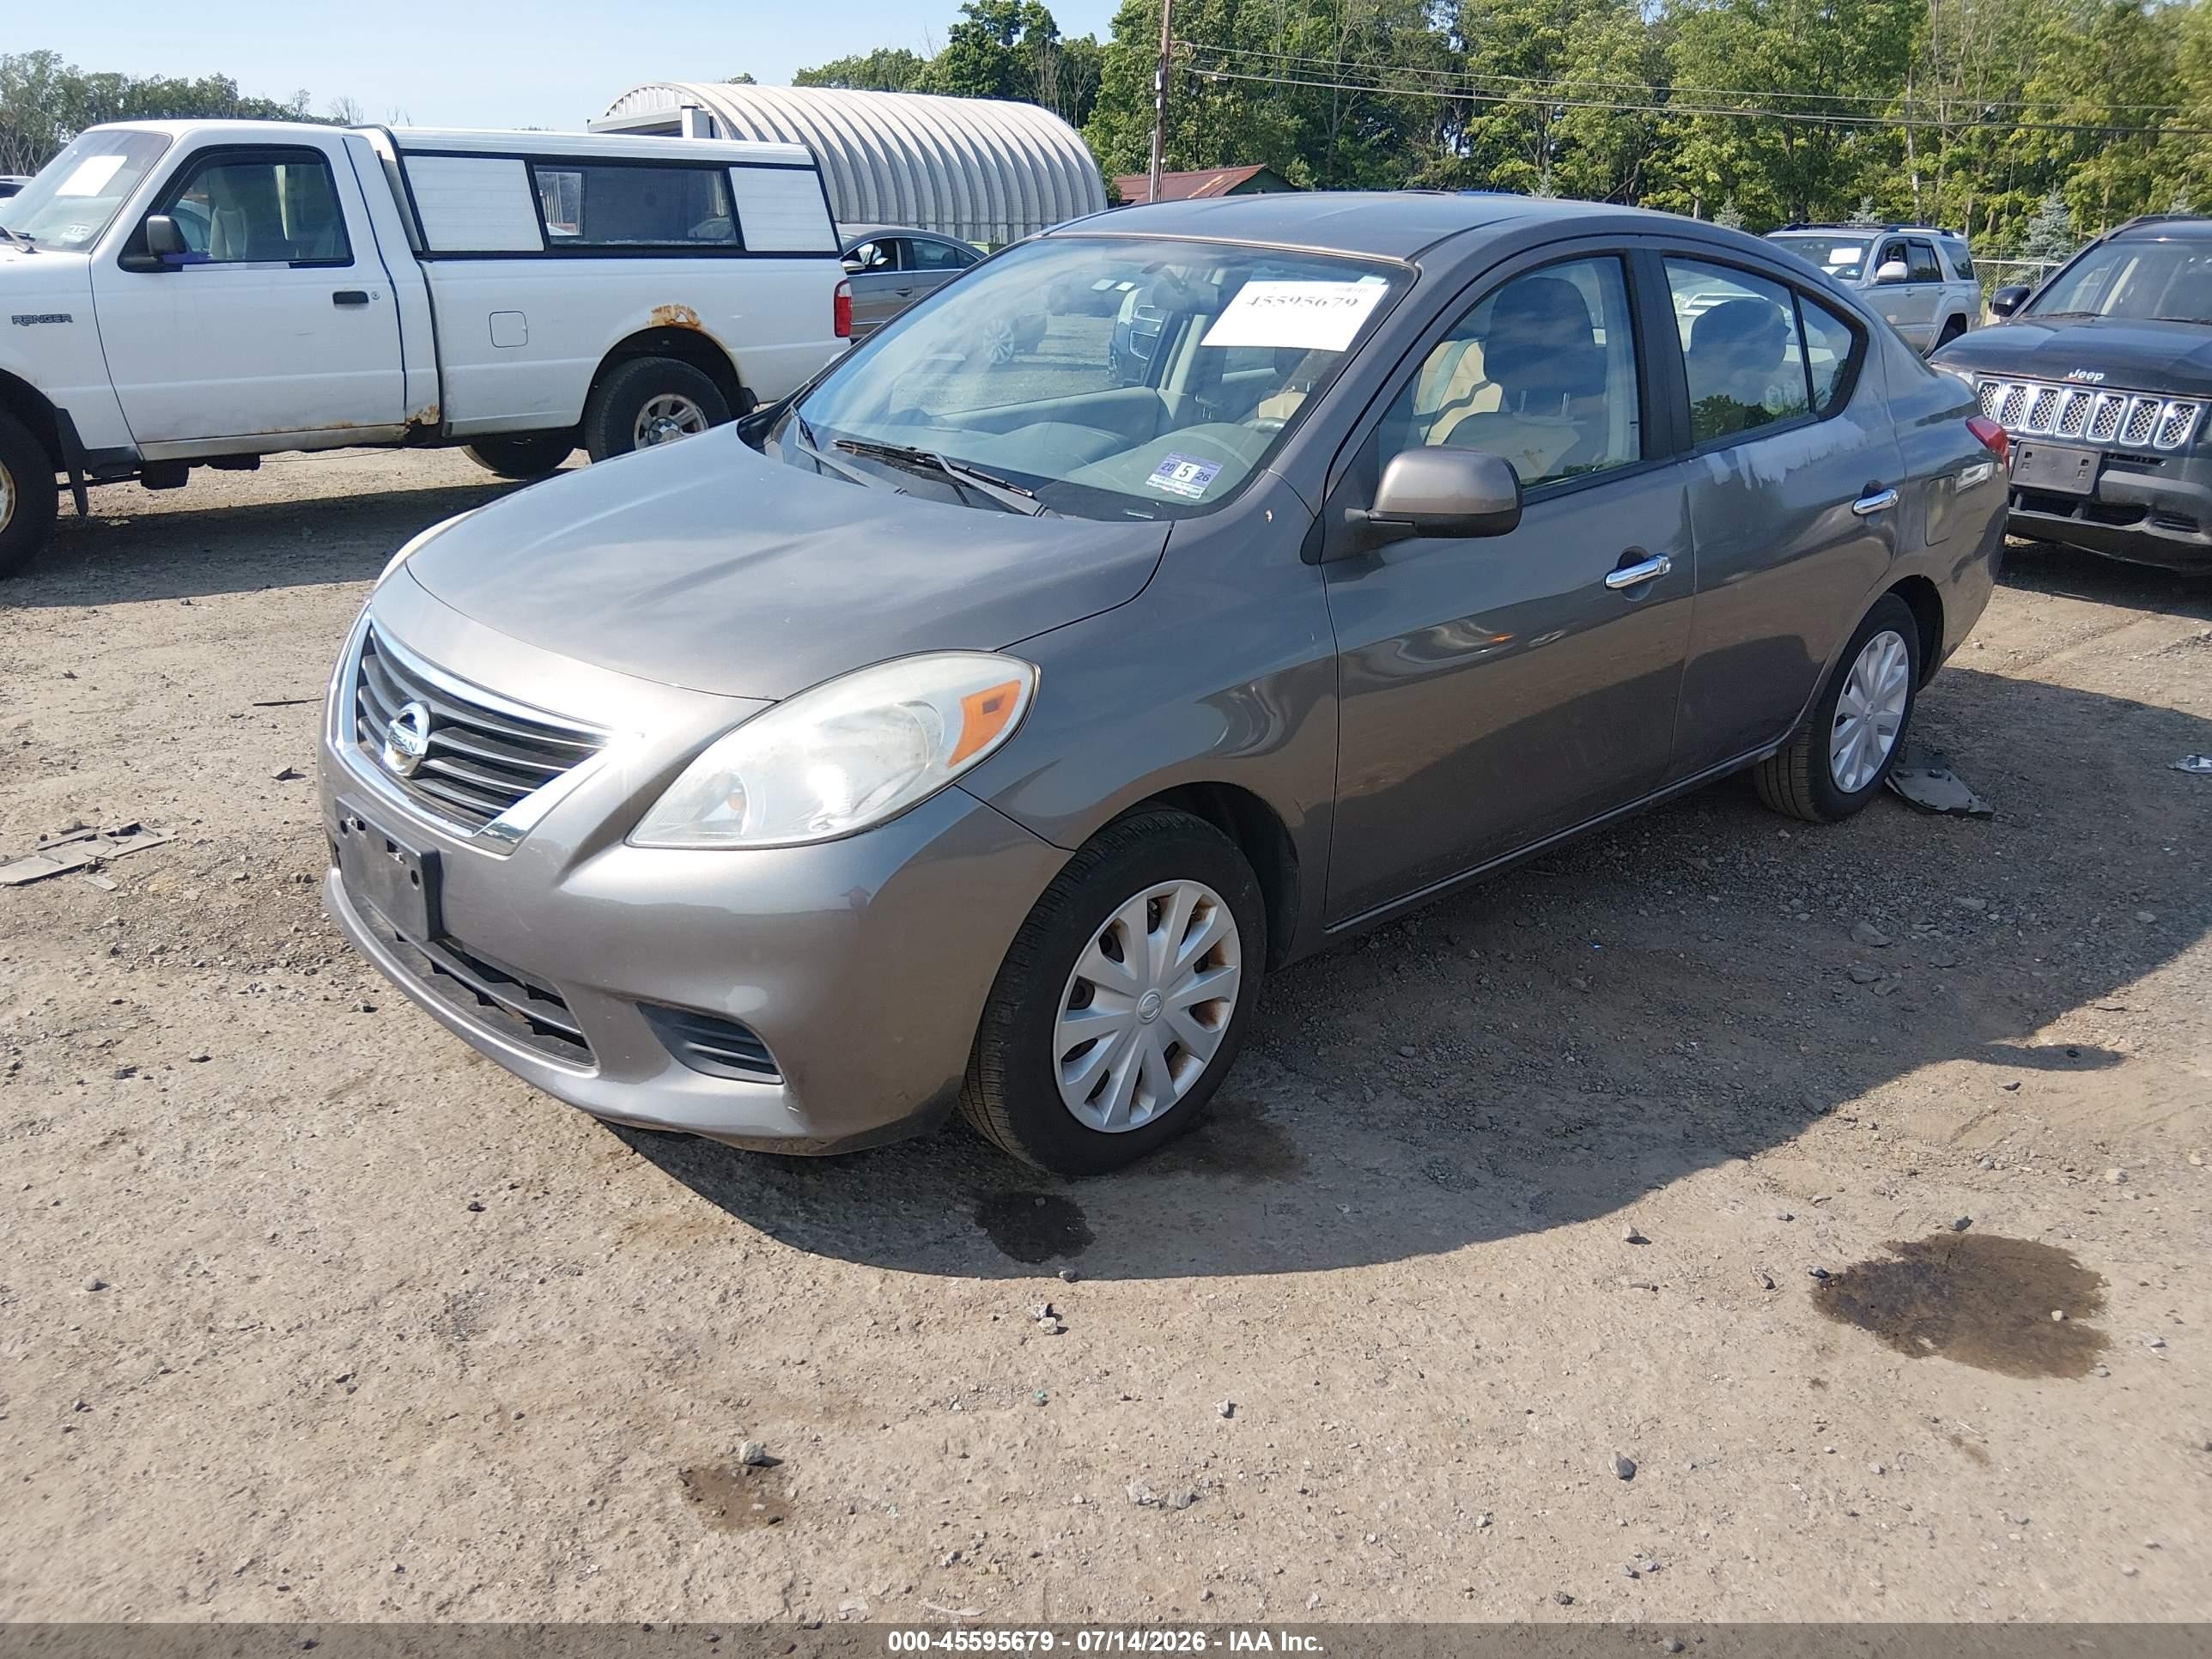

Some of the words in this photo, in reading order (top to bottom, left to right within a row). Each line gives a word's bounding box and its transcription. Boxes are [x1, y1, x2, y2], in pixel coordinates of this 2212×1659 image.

[1246, 295, 1359, 308] 45595679
[11, 313, 74, 326] RANGER
[2068, 368, 2105, 384] Jeep
[1161, 462, 1176, 472] 20
[1178, 465, 1193, 477] 5
[1194, 471, 1212, 482] 26
